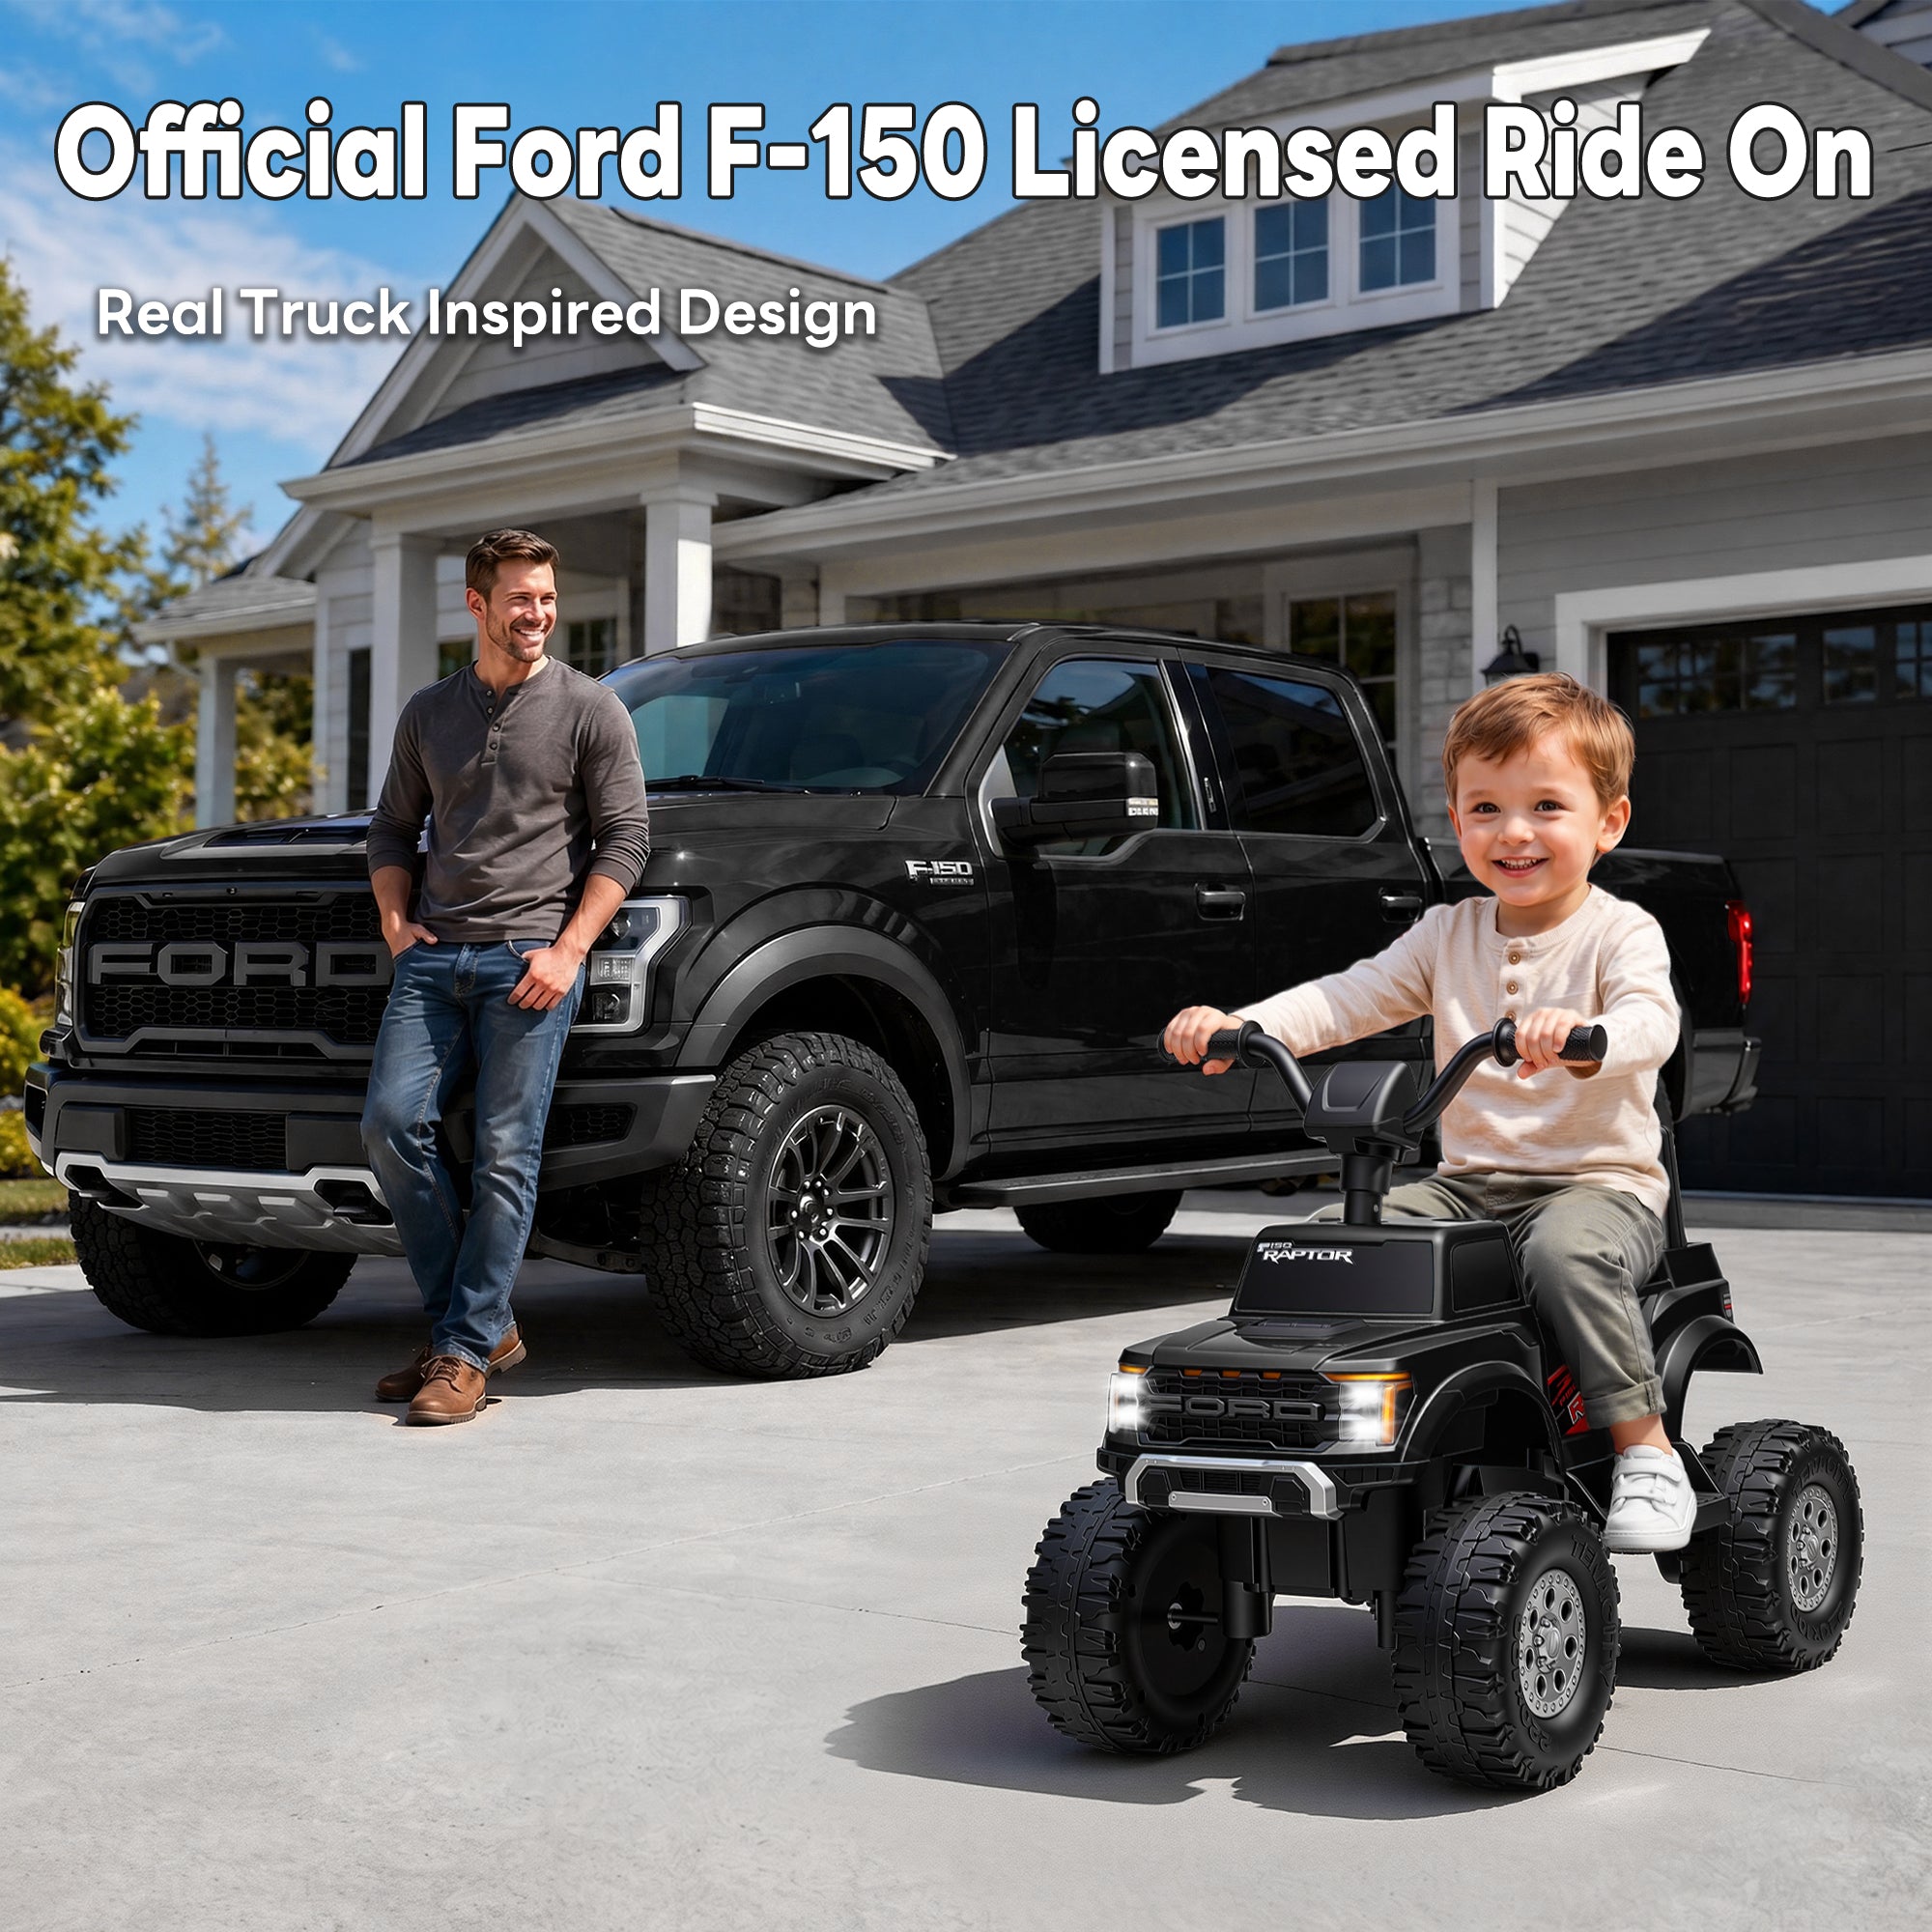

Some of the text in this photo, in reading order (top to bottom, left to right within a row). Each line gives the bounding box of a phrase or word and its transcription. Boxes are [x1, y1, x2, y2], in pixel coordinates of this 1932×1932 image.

[905, 860, 974, 880] F-150
[88, 941, 395, 986] FORD
[1263, 1249, 1355, 1264] RAPTOR
[1148, 1395, 1326, 1422] FORD
